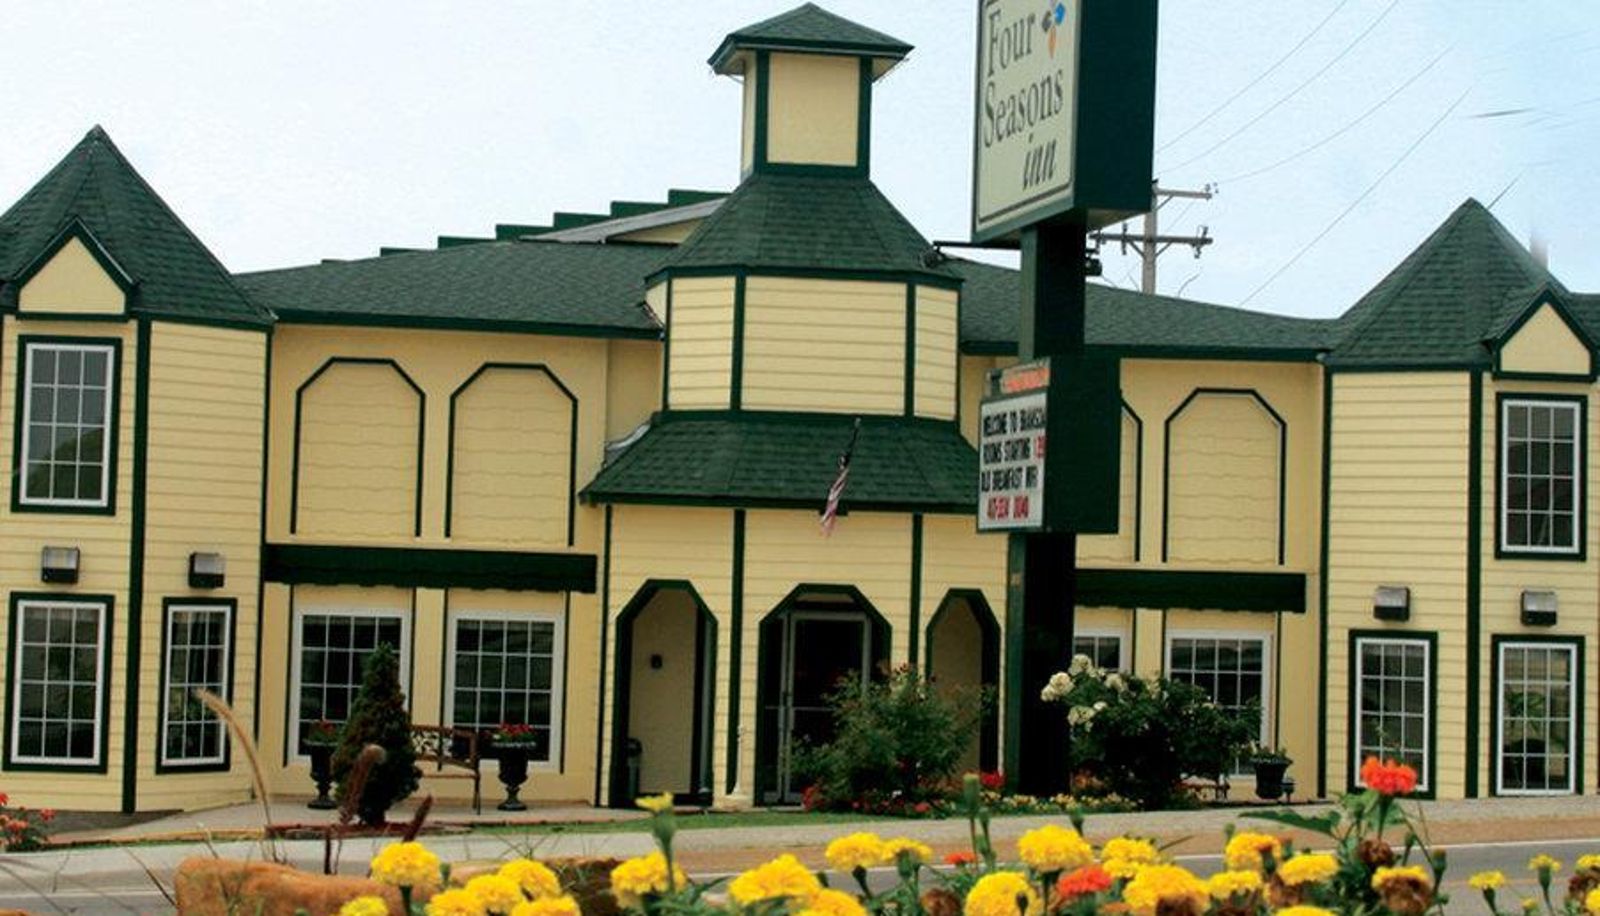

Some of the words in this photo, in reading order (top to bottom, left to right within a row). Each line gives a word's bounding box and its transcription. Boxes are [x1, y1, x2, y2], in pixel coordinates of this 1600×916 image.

[988, 9, 1036, 78] Four
[983, 69, 1064, 148] Seasons
[1022, 132, 1057, 191] inn
